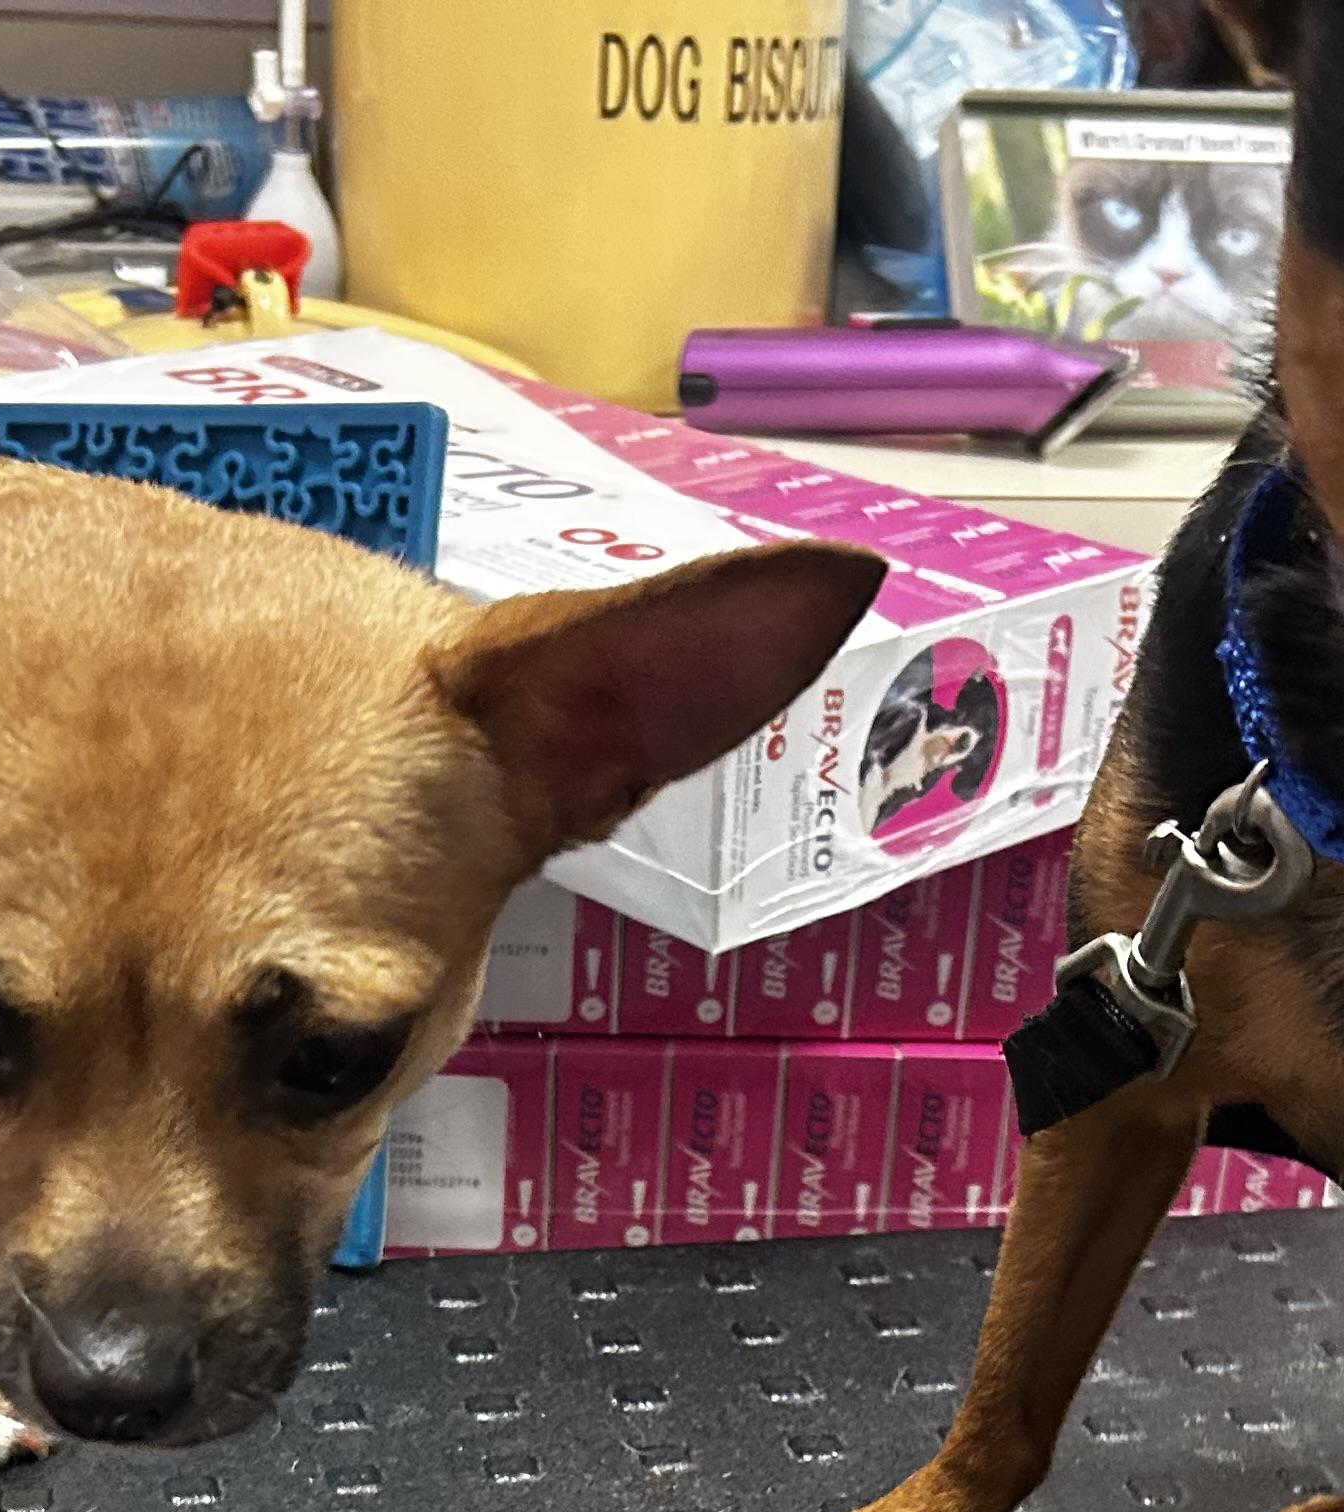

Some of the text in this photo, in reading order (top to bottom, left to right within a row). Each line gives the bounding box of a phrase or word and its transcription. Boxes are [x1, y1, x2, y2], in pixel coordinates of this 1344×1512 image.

[598, 33, 701, 121] DOG
[809, 688, 851, 872] BRAVECTO
[562, 1087, 613, 1224] BRAVECTO
[674, 1088, 725, 1225] BRAVECTO
[787, 1092, 837, 1227] BRAVECTO
[902, 1094, 945, 1228] BRAVECTO
